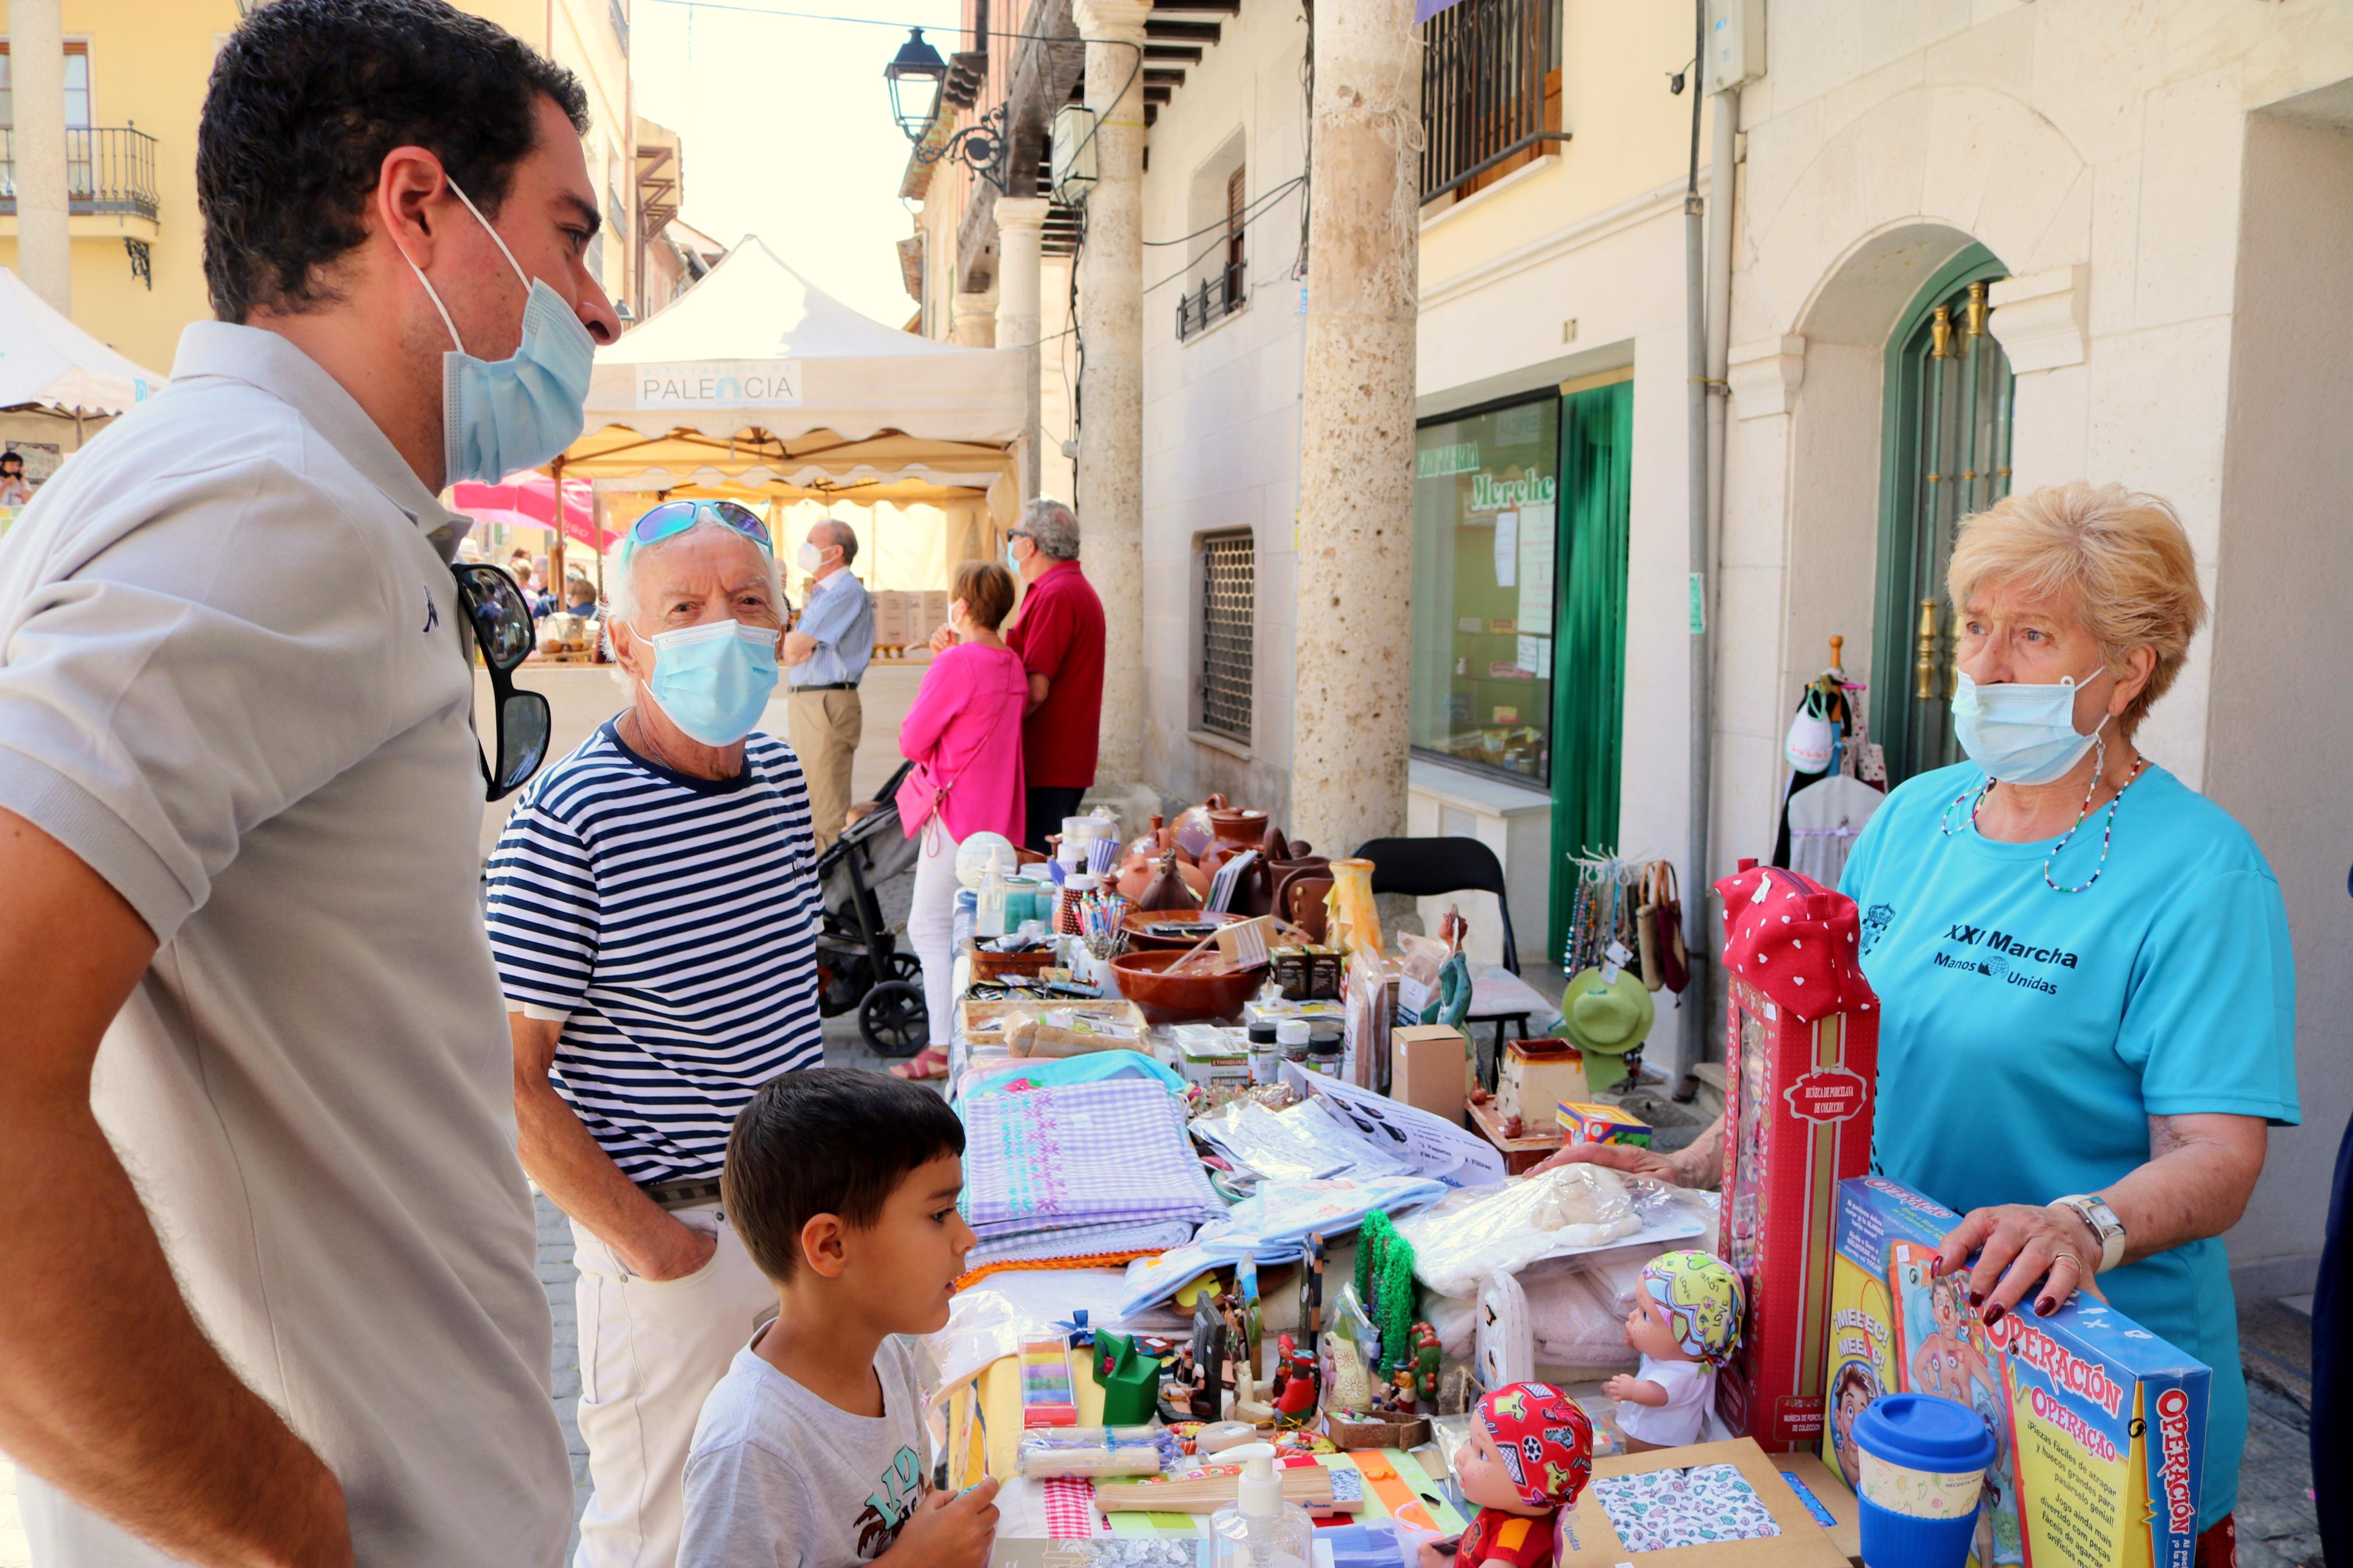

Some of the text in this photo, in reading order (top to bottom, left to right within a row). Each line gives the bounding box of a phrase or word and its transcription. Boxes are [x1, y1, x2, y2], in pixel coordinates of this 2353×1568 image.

[1471, 467, 1555, 512] Merche
[1943, 924, 2078, 969] XXI Marcha
[1933, 952, 2057, 995] Manos Unidas
[1805, 1085, 1854, 1098] MUÑECA DE PORCELANA
[1814, 1102, 1820, 1113] DE
[1679, 1276, 1691, 1300] LOVE
[1700, 1272, 1719, 1293] LOVE
[1712, 1300, 1729, 1327] LOVE
[1985, 1312, 2123, 1420] OPERACIÓN
[1784, 1414, 1801, 1423] MUÑECA
[2031, 1386, 2116, 1463] OPERAÇÃO
[2036, 1443, 2115, 1513] y huecos grandes para
[2053, 1439, 2076, 1466] fáciles
[2078, 1460, 2087, 1474] de
[2089, 1470, 2117, 1498] atrapar
[2156, 1388, 2195, 1534] OPERACIÓN
[2054, 1473, 2114, 1527] pasárselo genial!
[2055, 1494, 2112, 1548] Jogo ainda mais
[1563, 1526, 1582, 1552] Unidas
[2040, 1496, 2111, 1563] divertido com peças
[2042, 1511, 2103, 1568] fáceis de agarrar
[2183, 1539, 2190, 1548] Al
[2174, 1551, 2181, 1559] la
